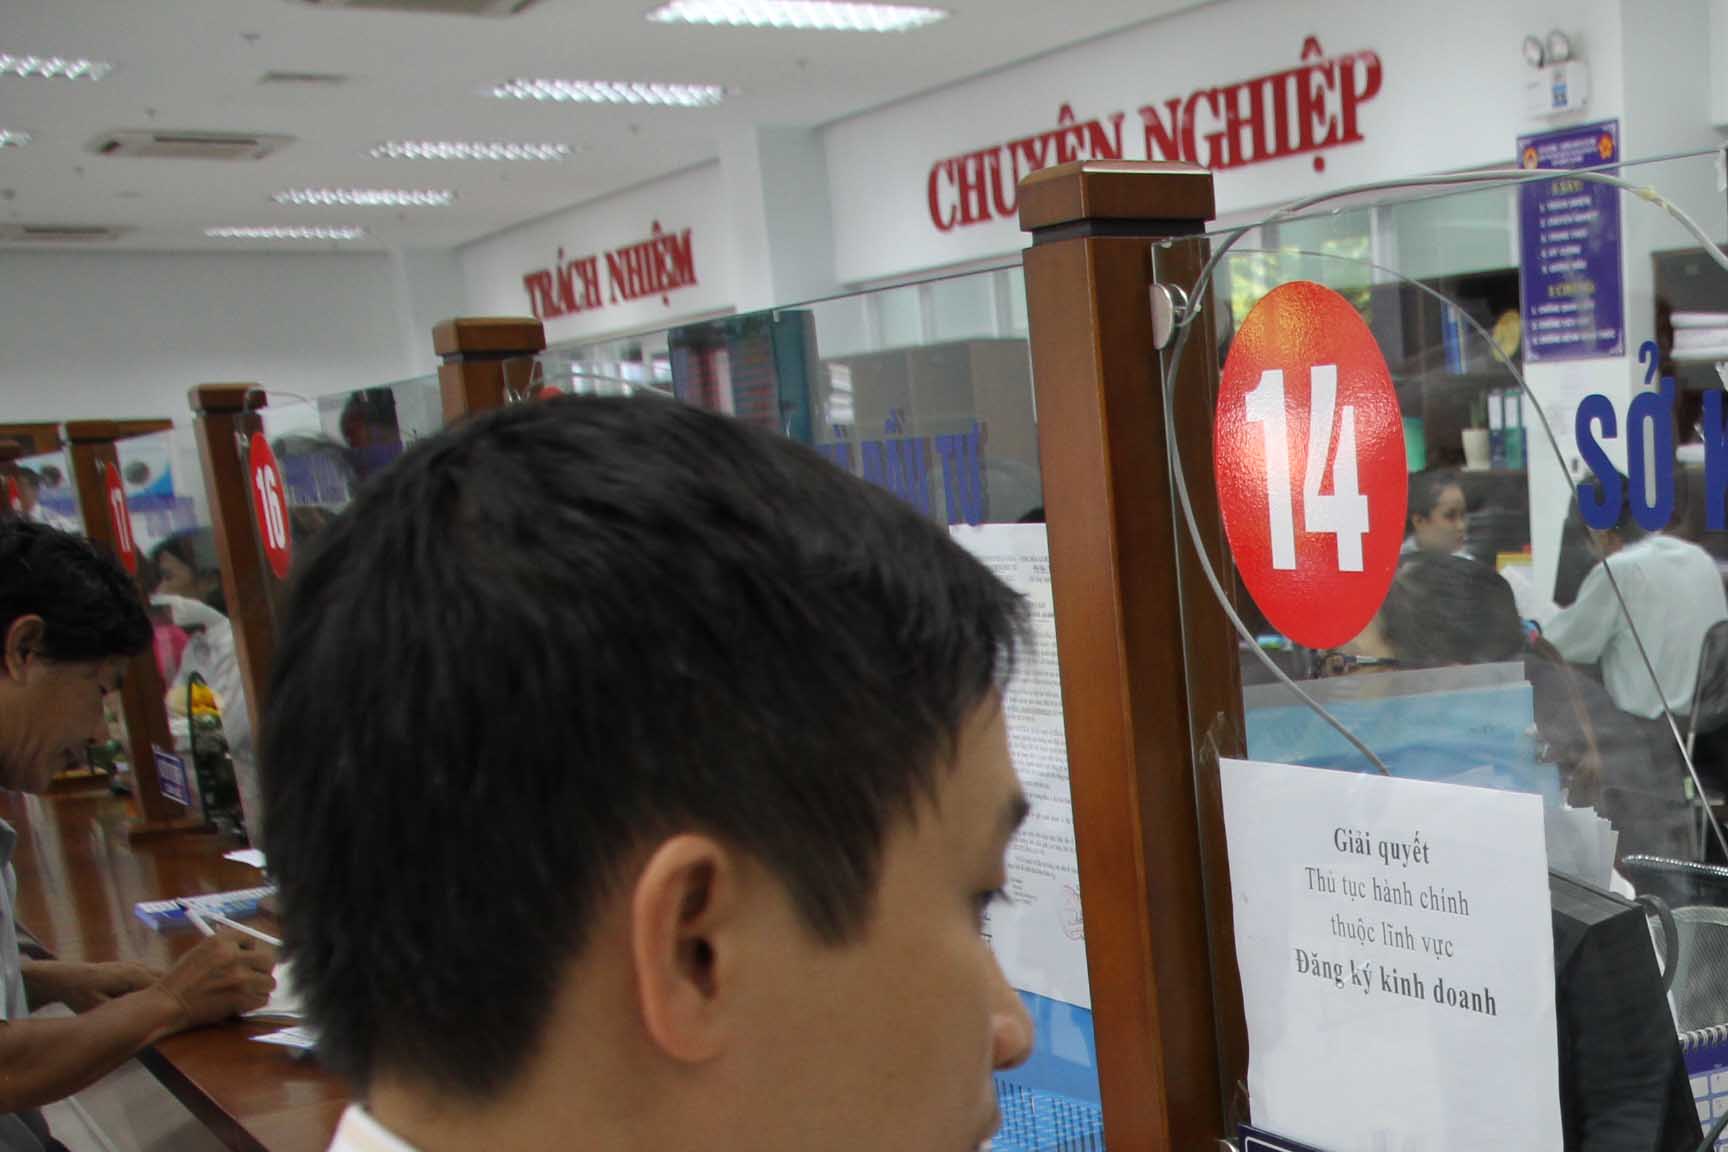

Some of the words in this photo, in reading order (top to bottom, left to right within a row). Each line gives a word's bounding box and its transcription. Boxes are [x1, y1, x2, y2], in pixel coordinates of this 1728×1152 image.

[1138, 34, 1384, 172] NGHIỆP
[523, 247, 603, 320] TRÁCH
[605, 219, 698, 306] NHIỆM
[1244, 364, 1370, 573] 14
[1575, 340, 1676, 532] SỞ
[256, 464, 286, 549] 16
[1334, 827, 1372, 856] Giải
[1378, 830, 1431, 868] quyết
[1304, 866, 1336, 894] Thủ
[1342, 875, 1367, 902] tục
[1372, 876, 1414, 908] hành
[1419, 886, 1471, 916] chính
[1330, 914, 1375, 944] thuộc
[1381, 921, 1416, 952] lĩnh
[1421, 933, 1455, 960] vực
[1295, 948, 1345, 989] Đăng
[1350, 958, 1373, 995] ký
[1379, 965, 1426, 1001] kinh
[1432, 978, 1498, 1017] doanh
